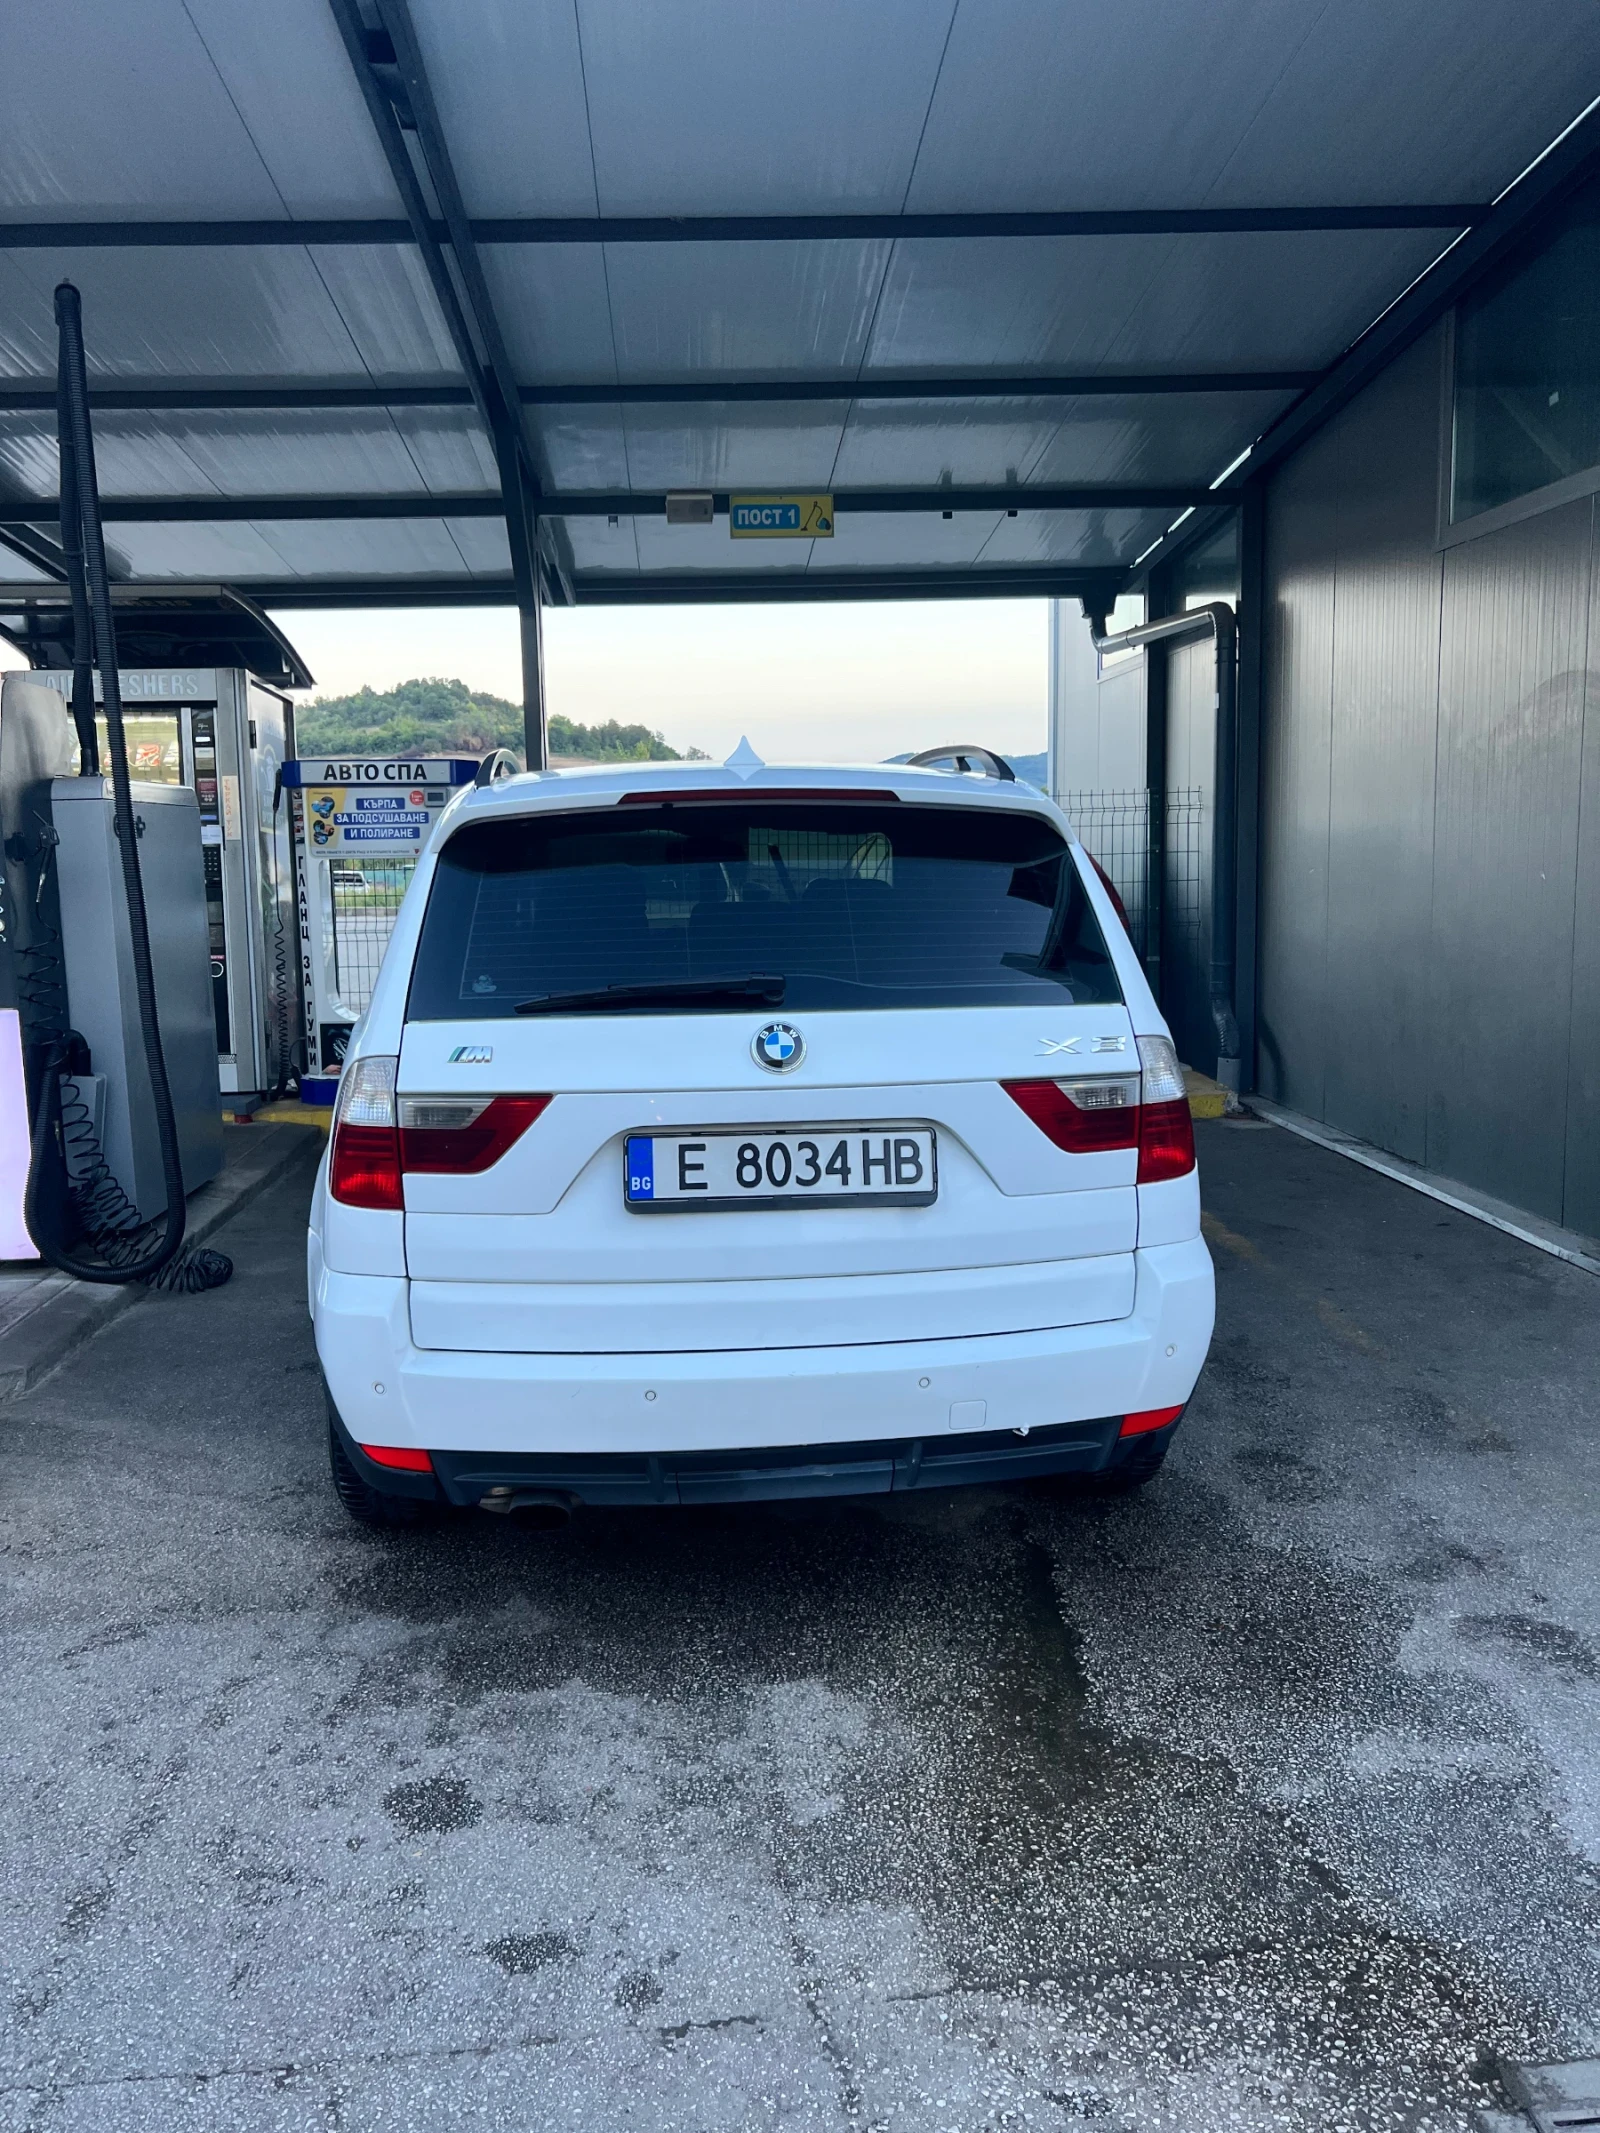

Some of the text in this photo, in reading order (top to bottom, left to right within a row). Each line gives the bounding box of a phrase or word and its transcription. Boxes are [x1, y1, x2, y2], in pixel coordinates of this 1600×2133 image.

[737, 509, 796, 525] ПОСТ 1
[323, 764, 428, 781] АВТО СПА
[363, 799, 398, 809] КЪРПА
[336, 812, 426, 824] ЗА ПОДСУШАВАНЕ
[350, 828, 414, 838] И ПОЛИРАНЕ
[298, 856, 317, 1067] ГЛАНЦ ЗА ГУМИ
[760, 1024, 798, 1039] BMW
[1034, 1036, 1126, 1057] X3
[678, 1138, 923, 1190] E 8034 HB
[631, 1176, 651, 1191] BG
